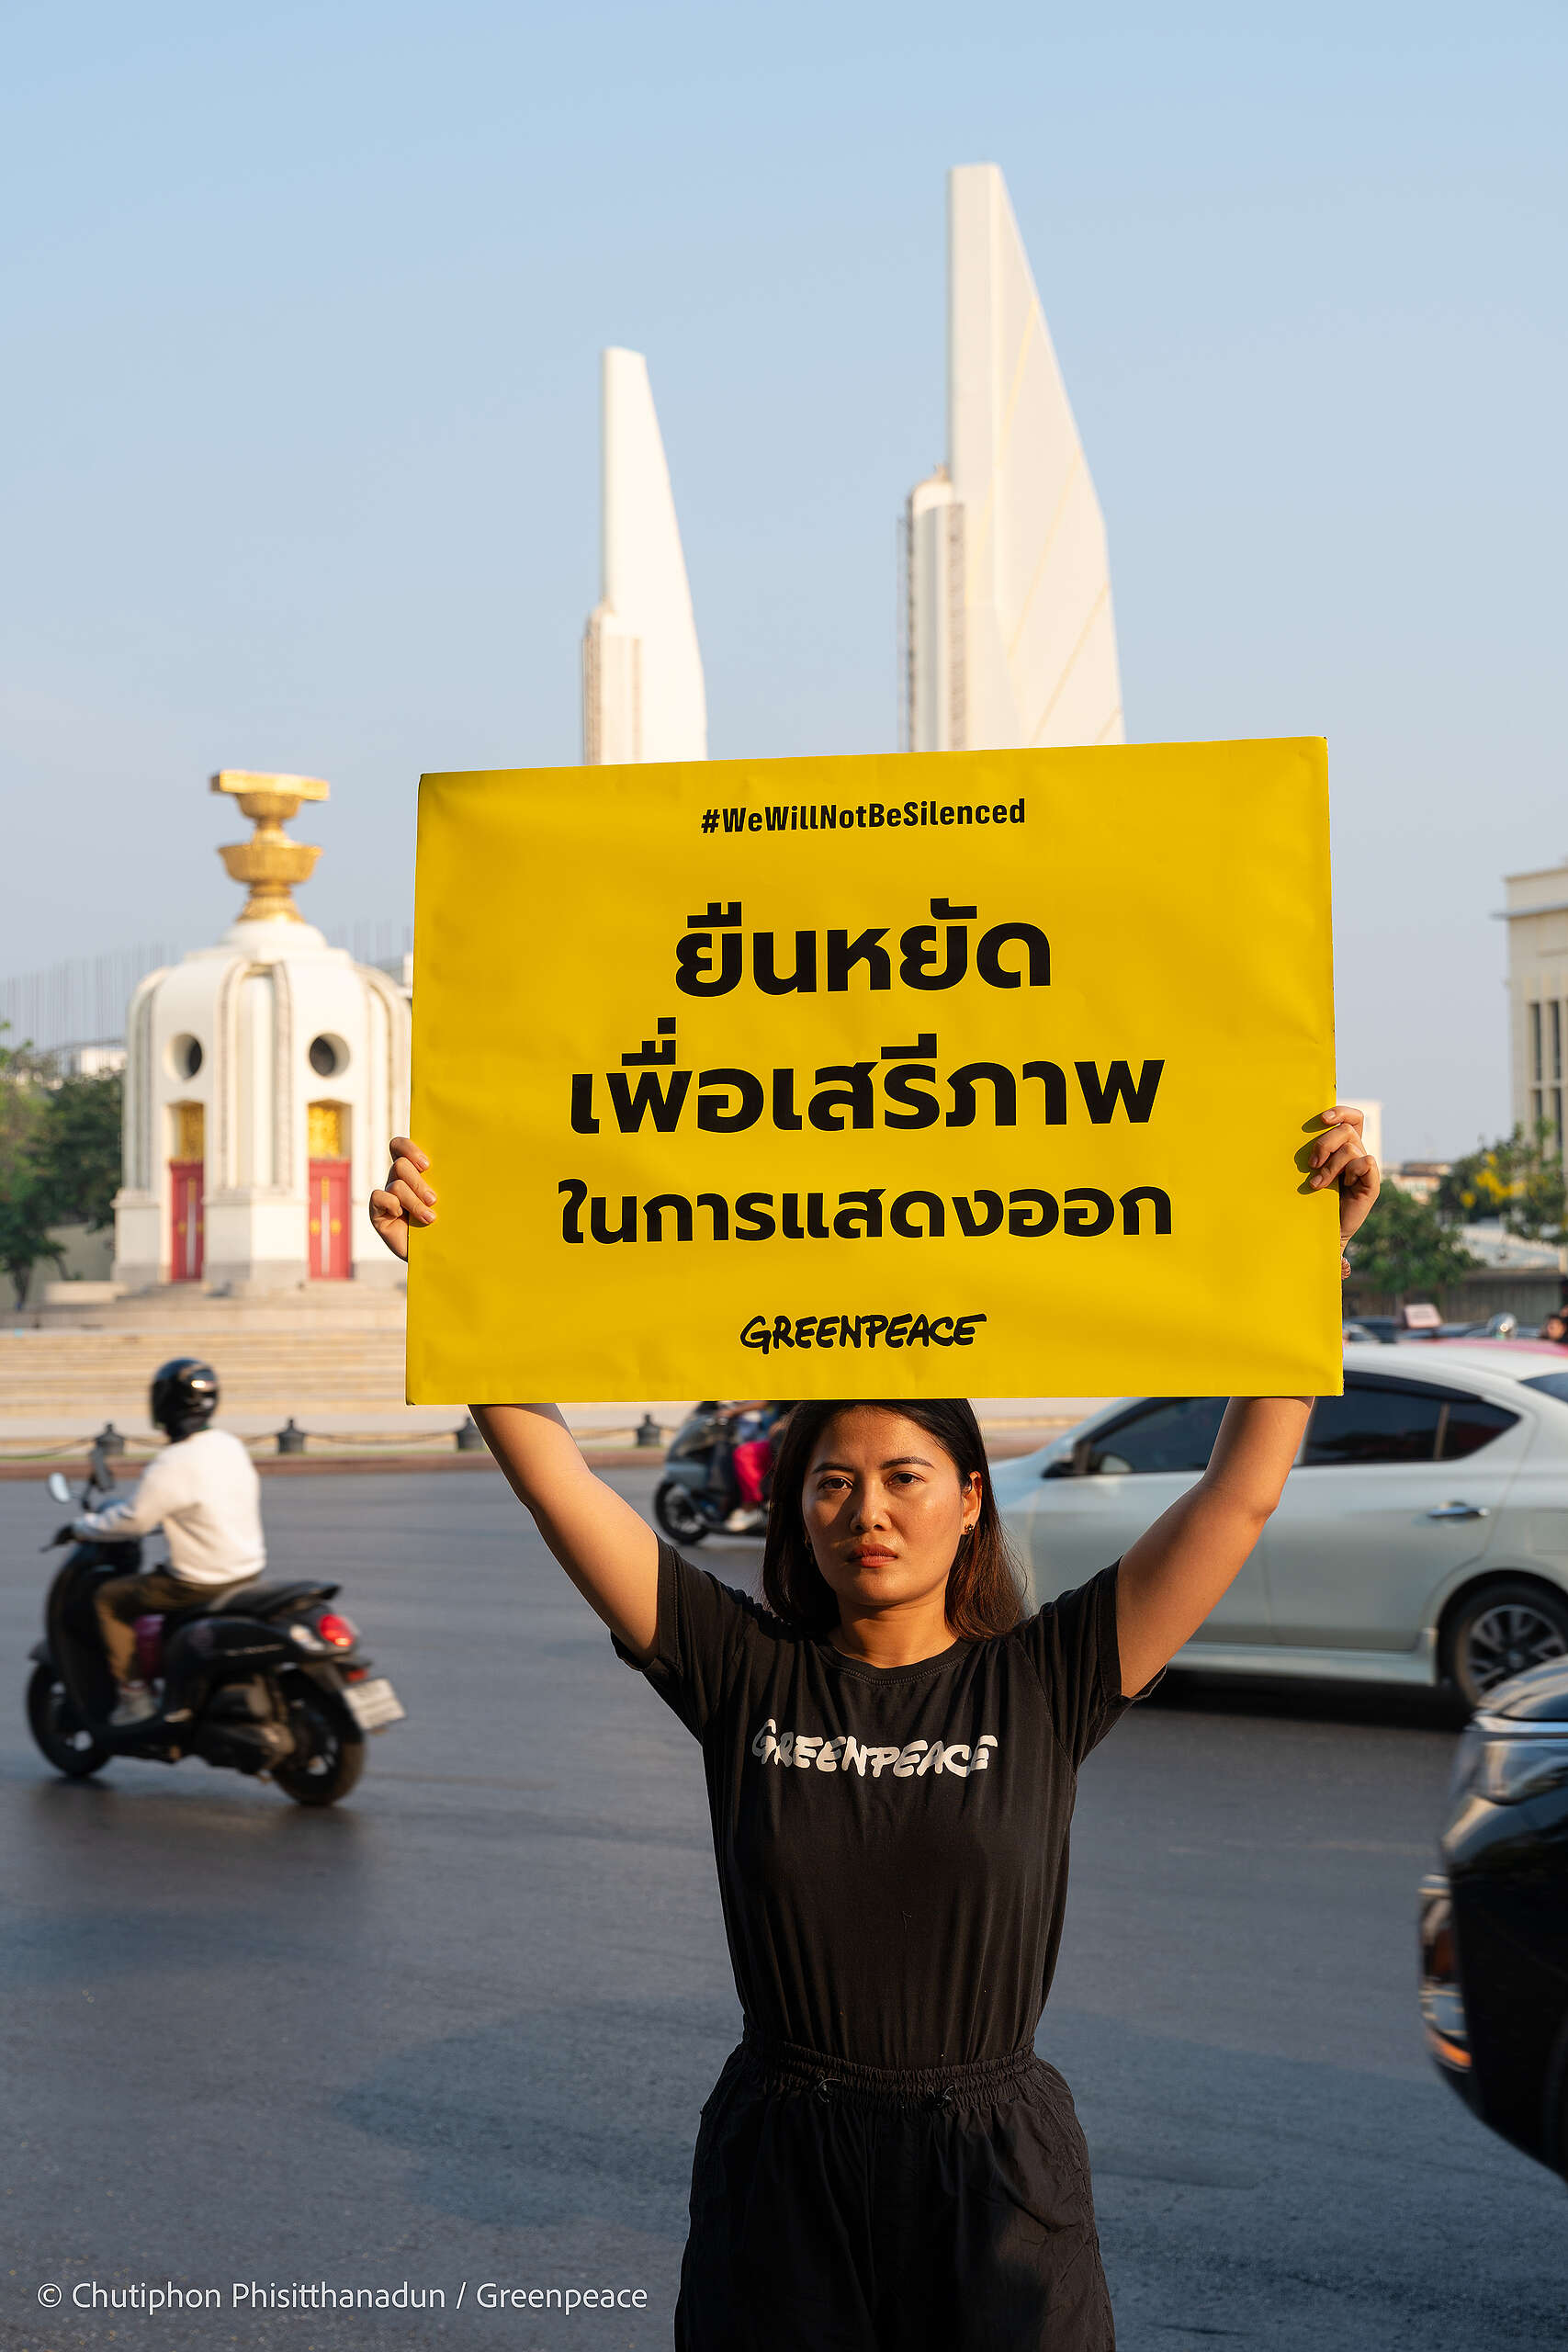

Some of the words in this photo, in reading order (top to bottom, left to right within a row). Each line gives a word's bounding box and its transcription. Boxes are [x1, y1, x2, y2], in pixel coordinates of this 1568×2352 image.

[701, 797, 1026, 834] #WeWillNotBeSilenced
[675, 897, 1052, 998] ยืนหยัด
[570, 1016, 1166, 1135] เพื่อเสรีภาพ
[558, 1178, 1172, 1245] ในการแสดงออก
[739, 1312, 987, 1355] GREENPEACE
[751, 1718, 998, 1778] GREENPEACE
